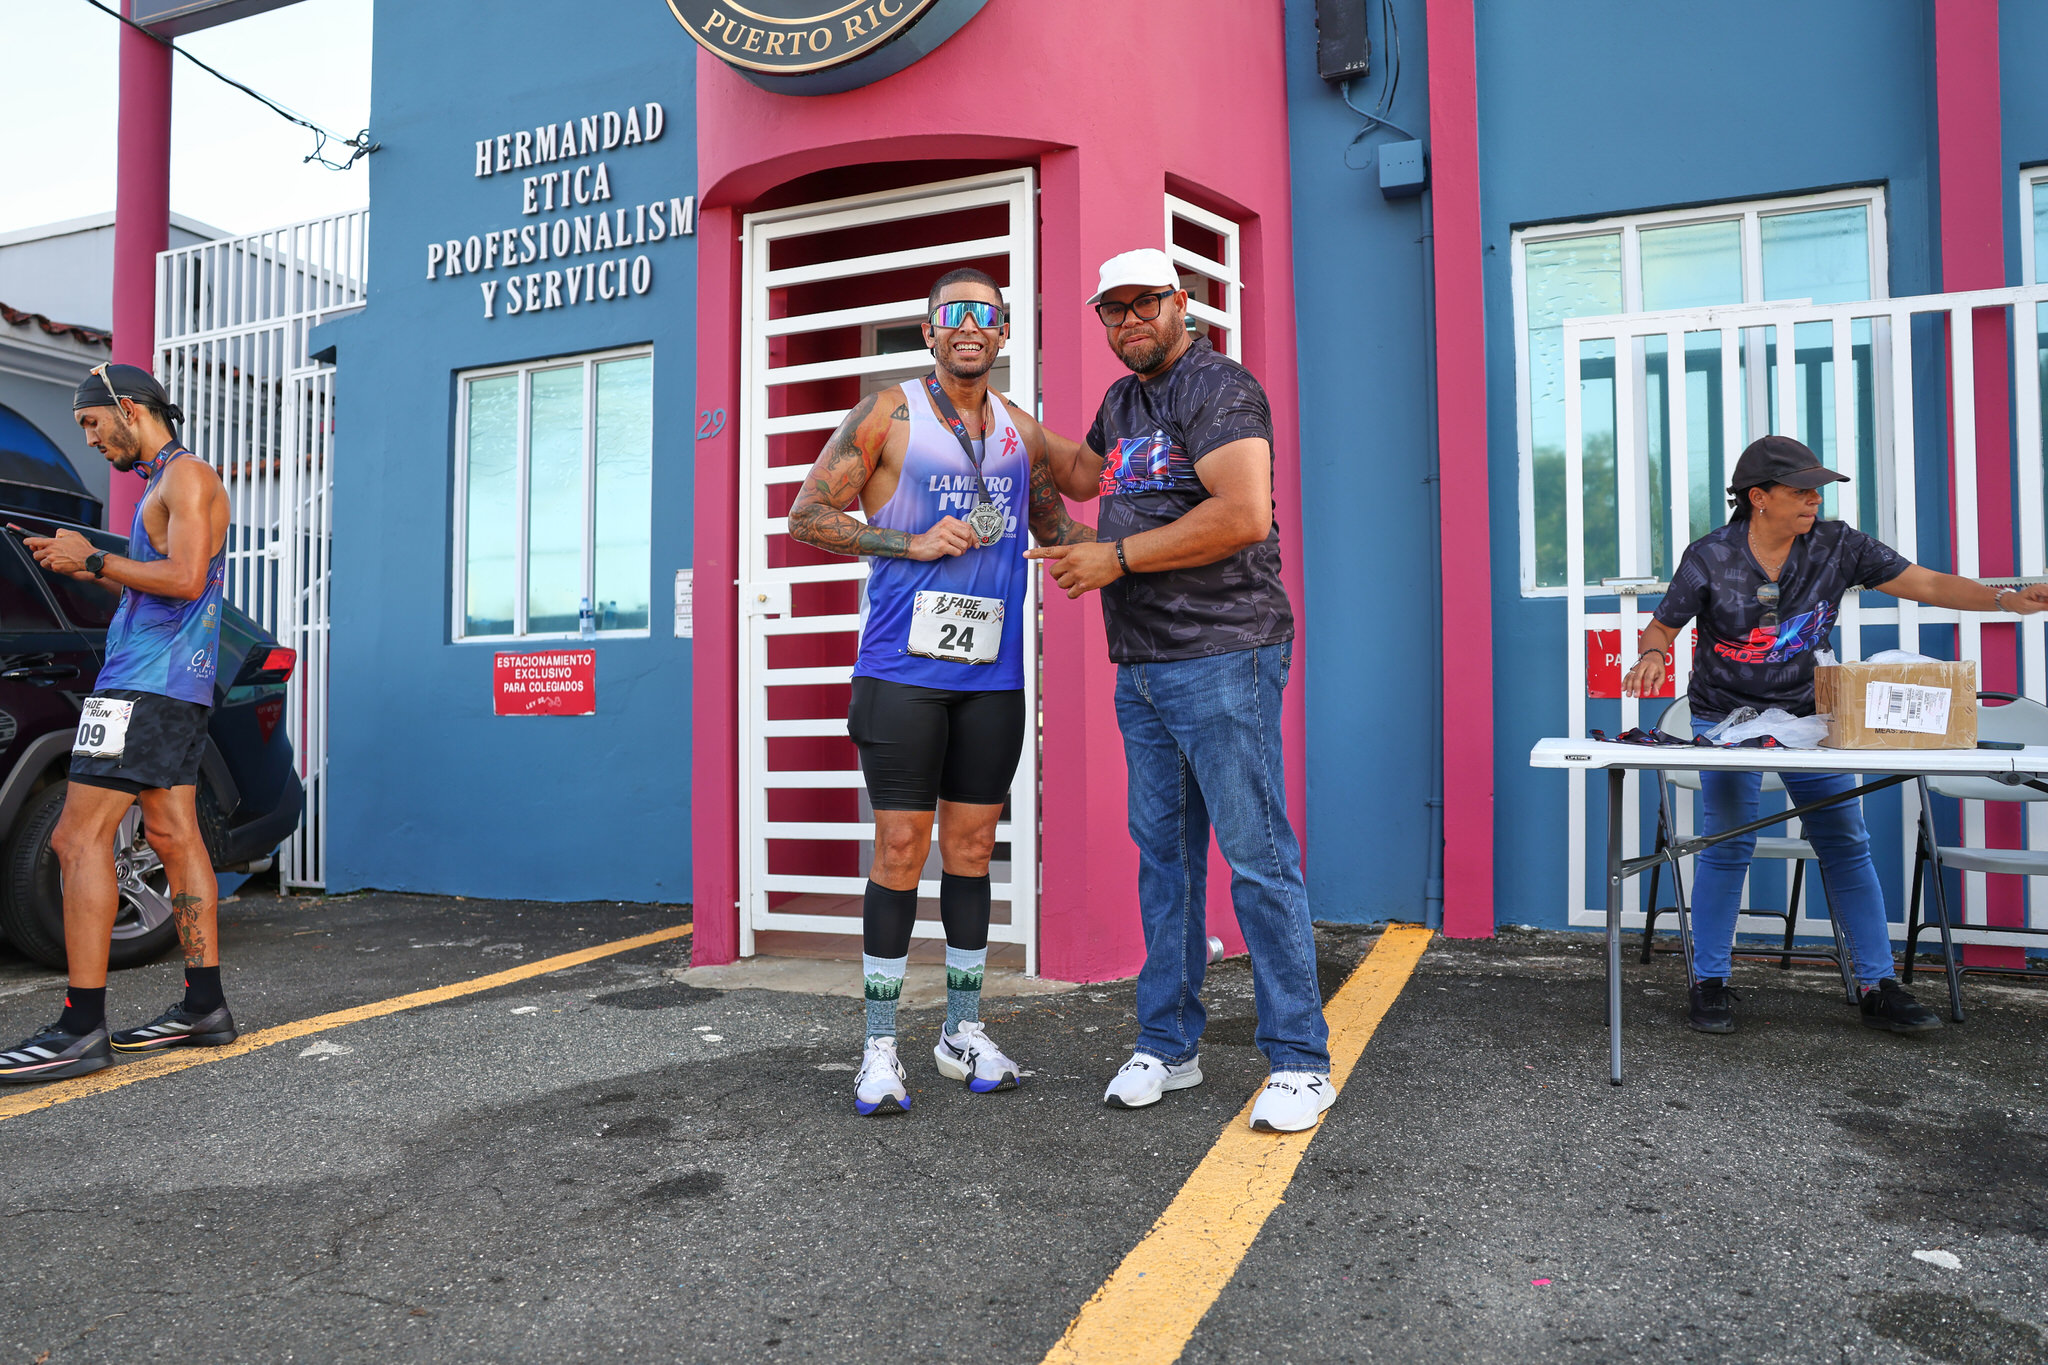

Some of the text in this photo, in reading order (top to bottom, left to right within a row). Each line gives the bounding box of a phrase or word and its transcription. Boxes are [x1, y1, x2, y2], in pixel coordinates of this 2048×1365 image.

[701, 9, 833, 56] PUERTO
[475, 102, 664, 177] HERMANDAD
[522, 162, 611, 214] ETICA
[426, 196, 694, 279] PROFESIONALISM
[481, 255, 651, 318] Y SERVICIO
[696, 408, 727, 440] 29
[929, 475, 951, 492] LA
[949, 597, 981, 610] FADE
[963, 610, 989, 620] RUN
[938, 624, 974, 652] 24
[497, 654, 591, 668] ESTACIONAMIENTO
[1714, 643, 1767, 664] FADE
[515, 667, 572, 679] EXCLUSIVO
[504, 681, 584, 693] PARA COLEGIADOS
[90, 709, 112, 718] RUN
[79, 723, 106, 747] 09
